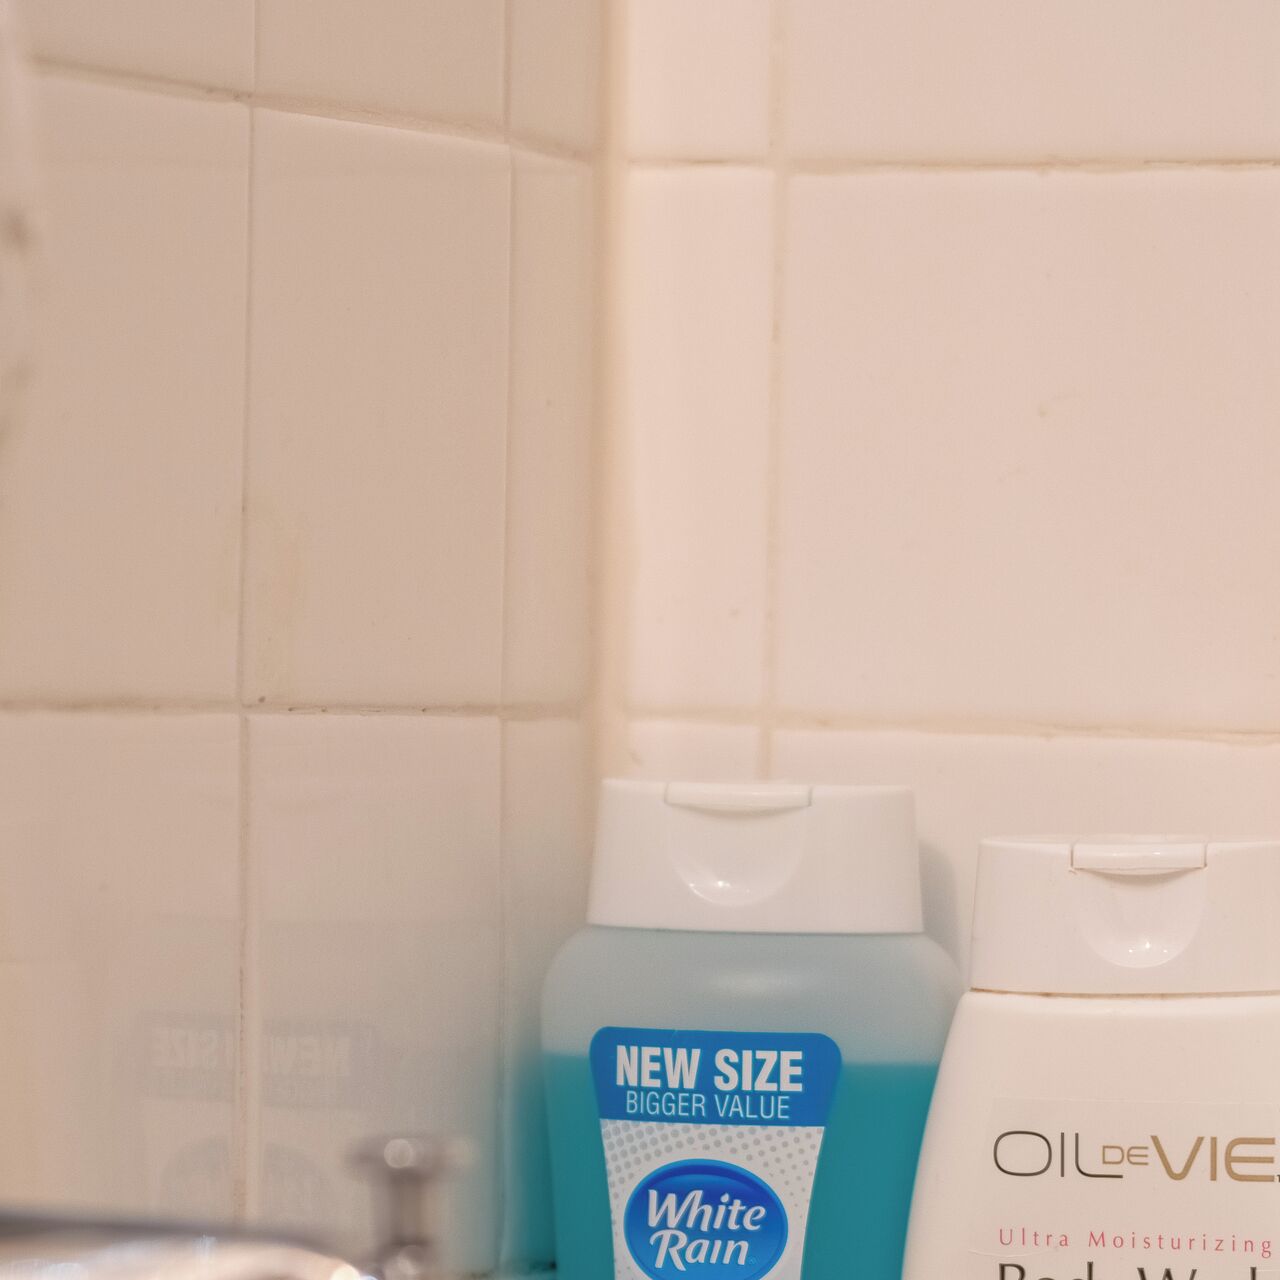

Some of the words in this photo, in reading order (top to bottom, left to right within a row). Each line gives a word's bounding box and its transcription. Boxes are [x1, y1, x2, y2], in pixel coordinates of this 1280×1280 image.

[616, 1045, 701, 1089] NEW
[714, 1049, 803, 1092] SIZE
[626, 1091, 705, 1117] BIGGER
[715, 1094, 790, 1119] VALUE
[647, 1189, 766, 1232] White
[649, 1229, 749, 1271] Rain
[999, 1227, 1069, 1248] Ultra
[1088, 1231, 1272, 1259] Moisturizing
